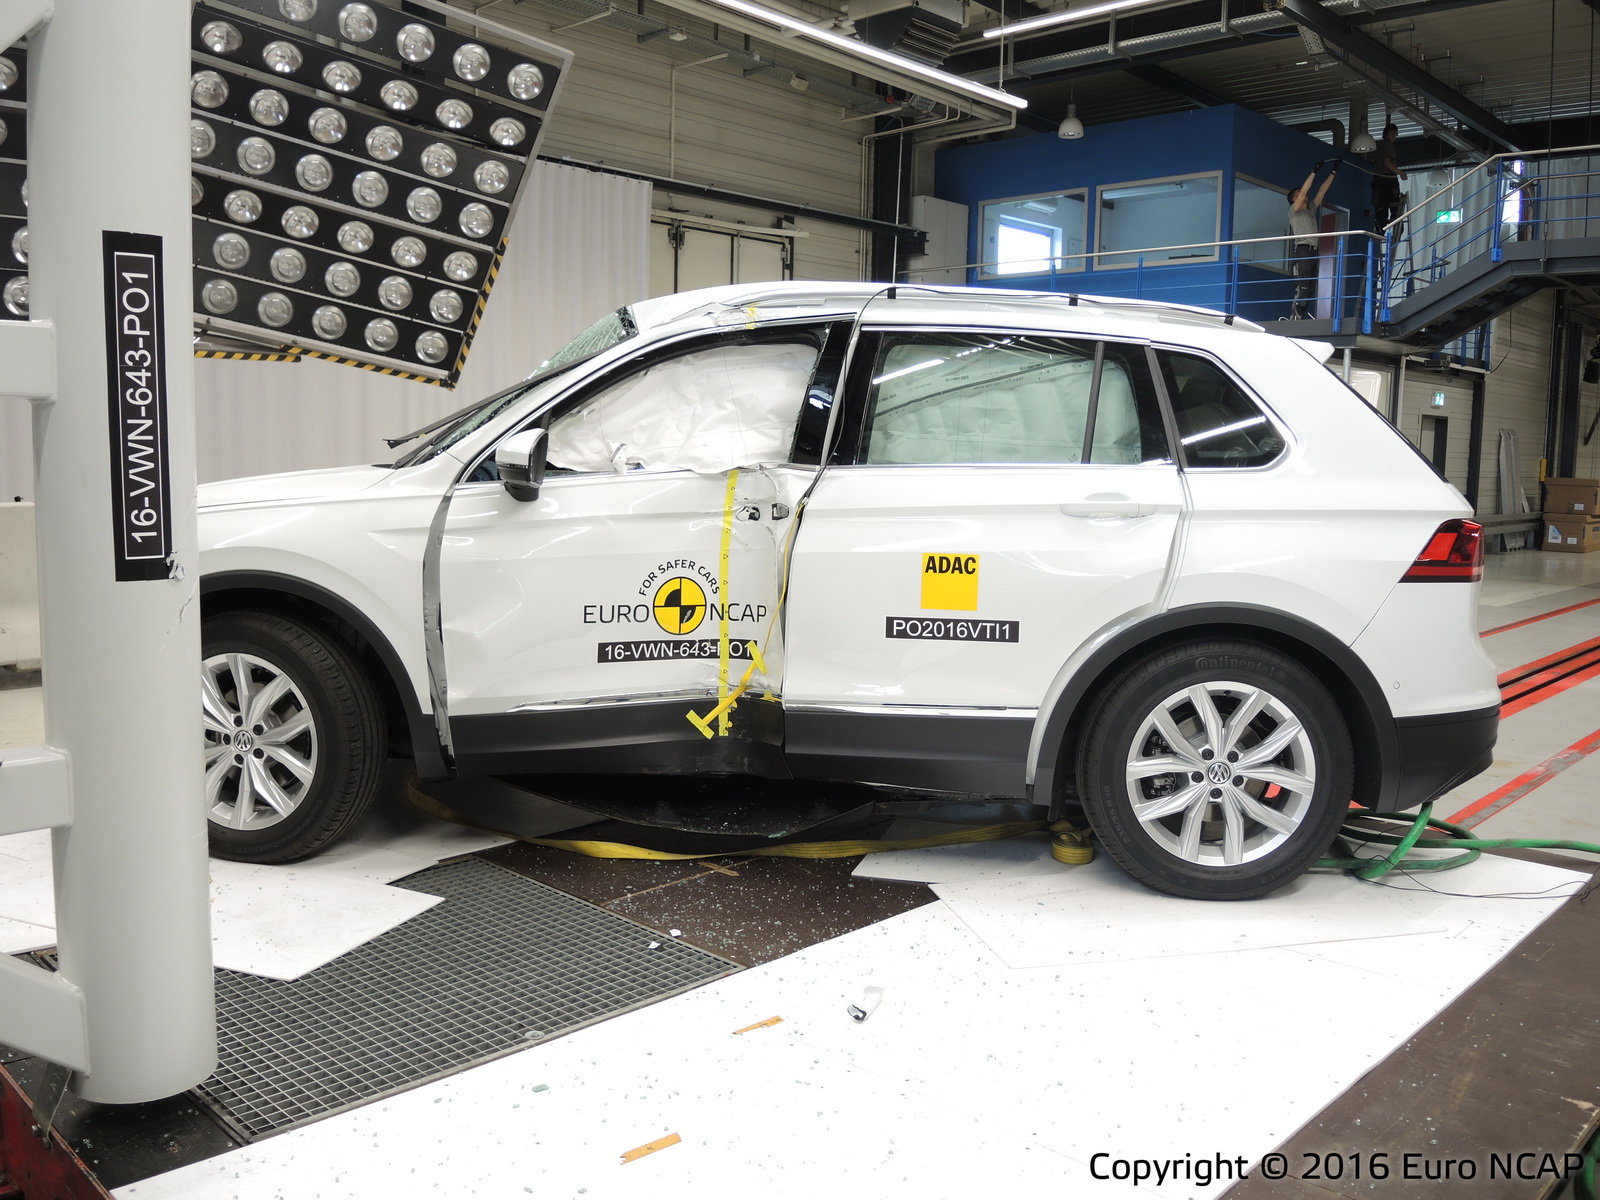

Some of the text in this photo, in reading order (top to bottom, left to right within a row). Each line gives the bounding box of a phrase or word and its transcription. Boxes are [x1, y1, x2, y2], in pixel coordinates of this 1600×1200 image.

[121, 271, 158, 543] 16-VWN-643-PO1
[924, 555, 977, 575] ADAC
[638, 559, 720, 596] FOR SAFER CARS
[583, 603, 767, 624] EURO NCAP
[892, 619, 1010, 640] PO2016VTI1
[604, 640, 752, 660] 16-VWN-643-O1
[1194, 655, 1276, 677] Continental
